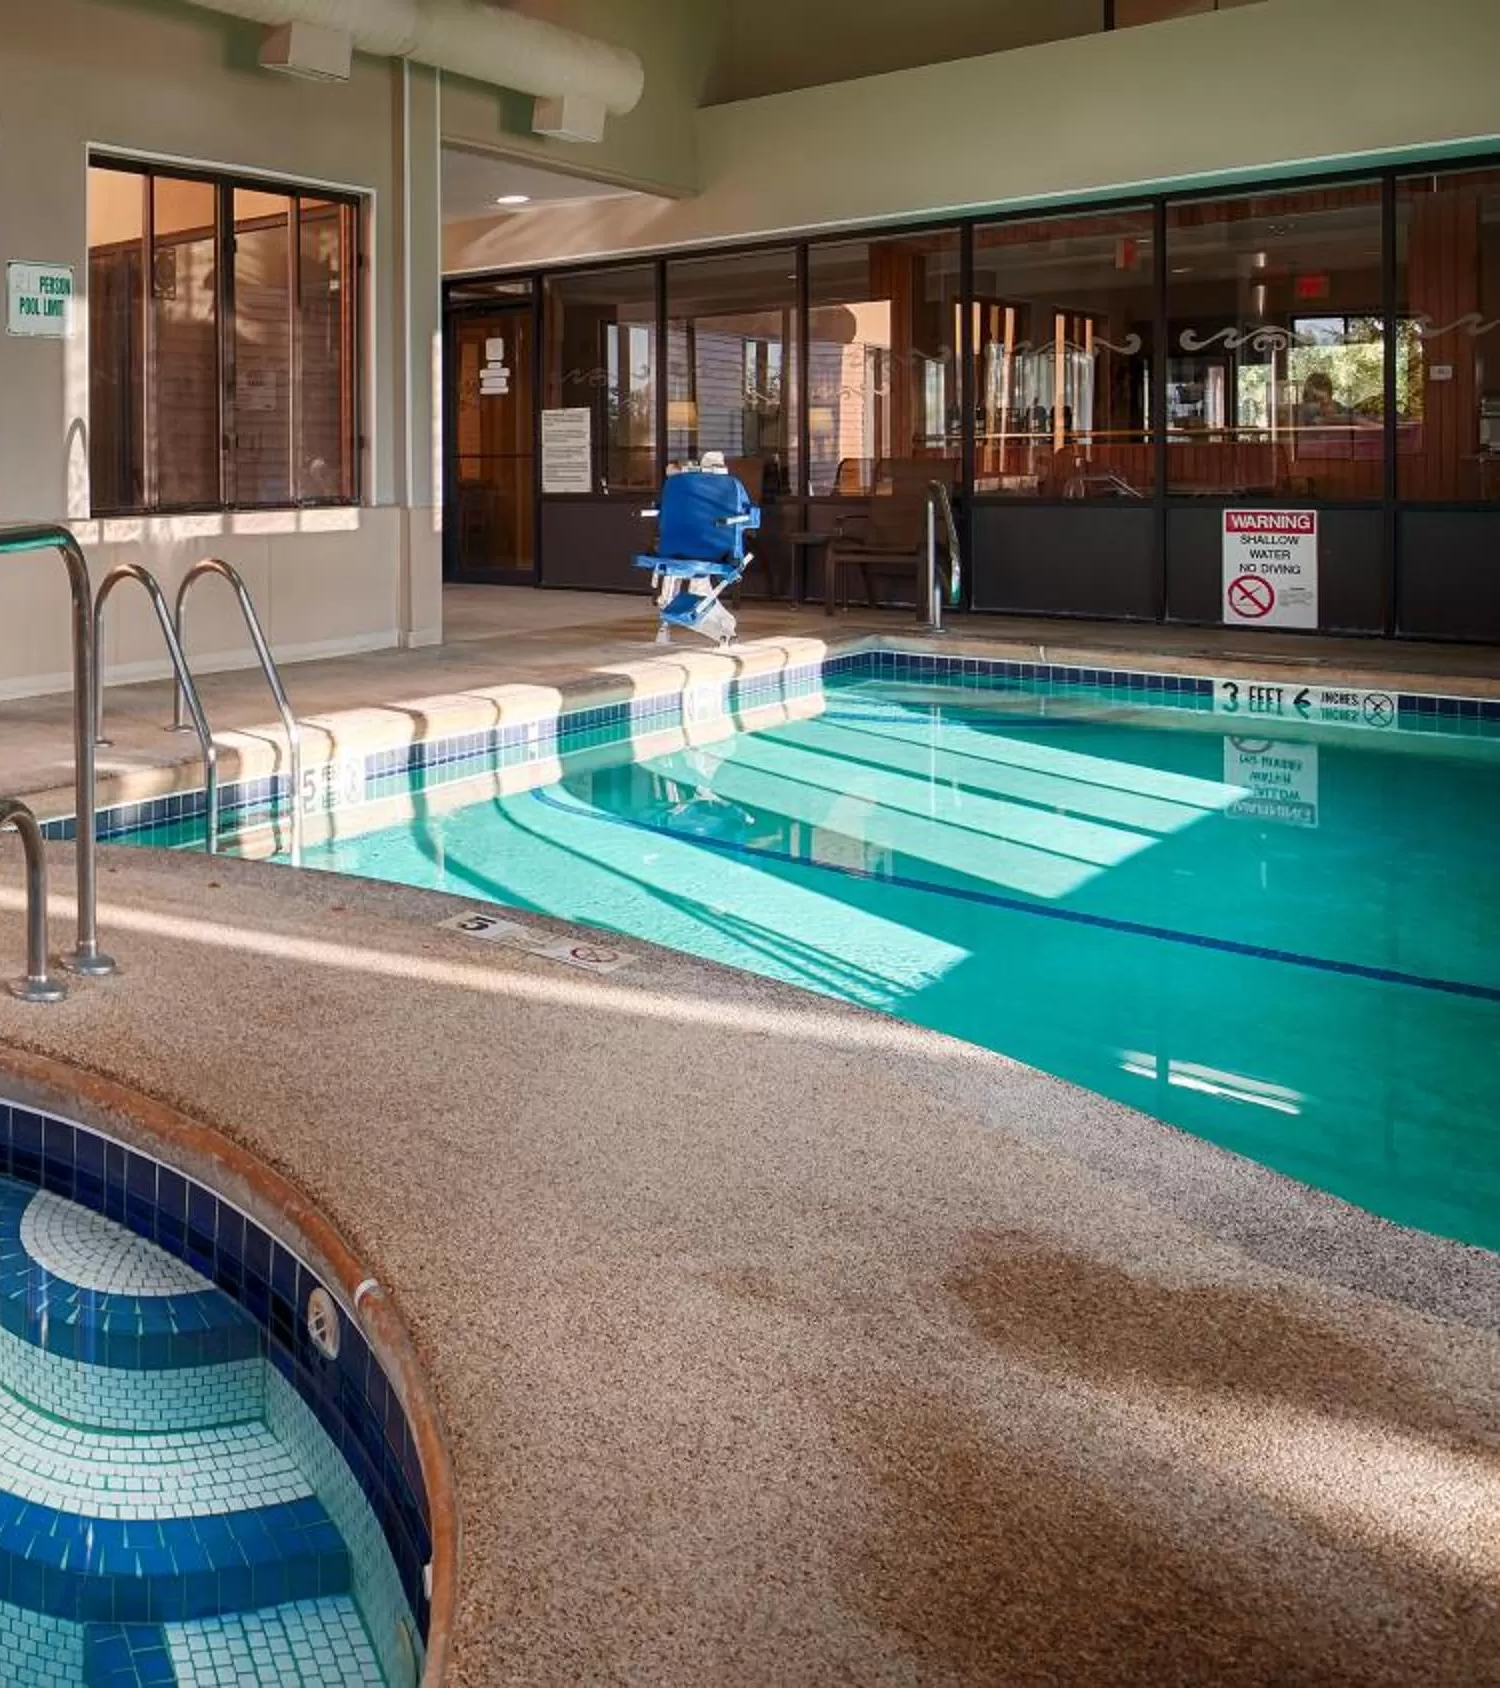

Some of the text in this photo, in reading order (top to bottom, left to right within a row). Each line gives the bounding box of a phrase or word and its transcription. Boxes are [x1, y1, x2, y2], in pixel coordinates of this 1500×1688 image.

[40, 275, 70, 295] PERSON
[20, 296, 40, 315] POOL
[1231, 514, 1311, 529] WARNING
[1240, 534, 1300, 545] SHALLOW
[1249, 549, 1291, 560] WATER
[1239, 563, 1301, 575] NO DIVING
[1222, 682, 1239, 711] 3
[1321, 691, 1360, 706] INCHES
[457, 916, 498, 931] 5
